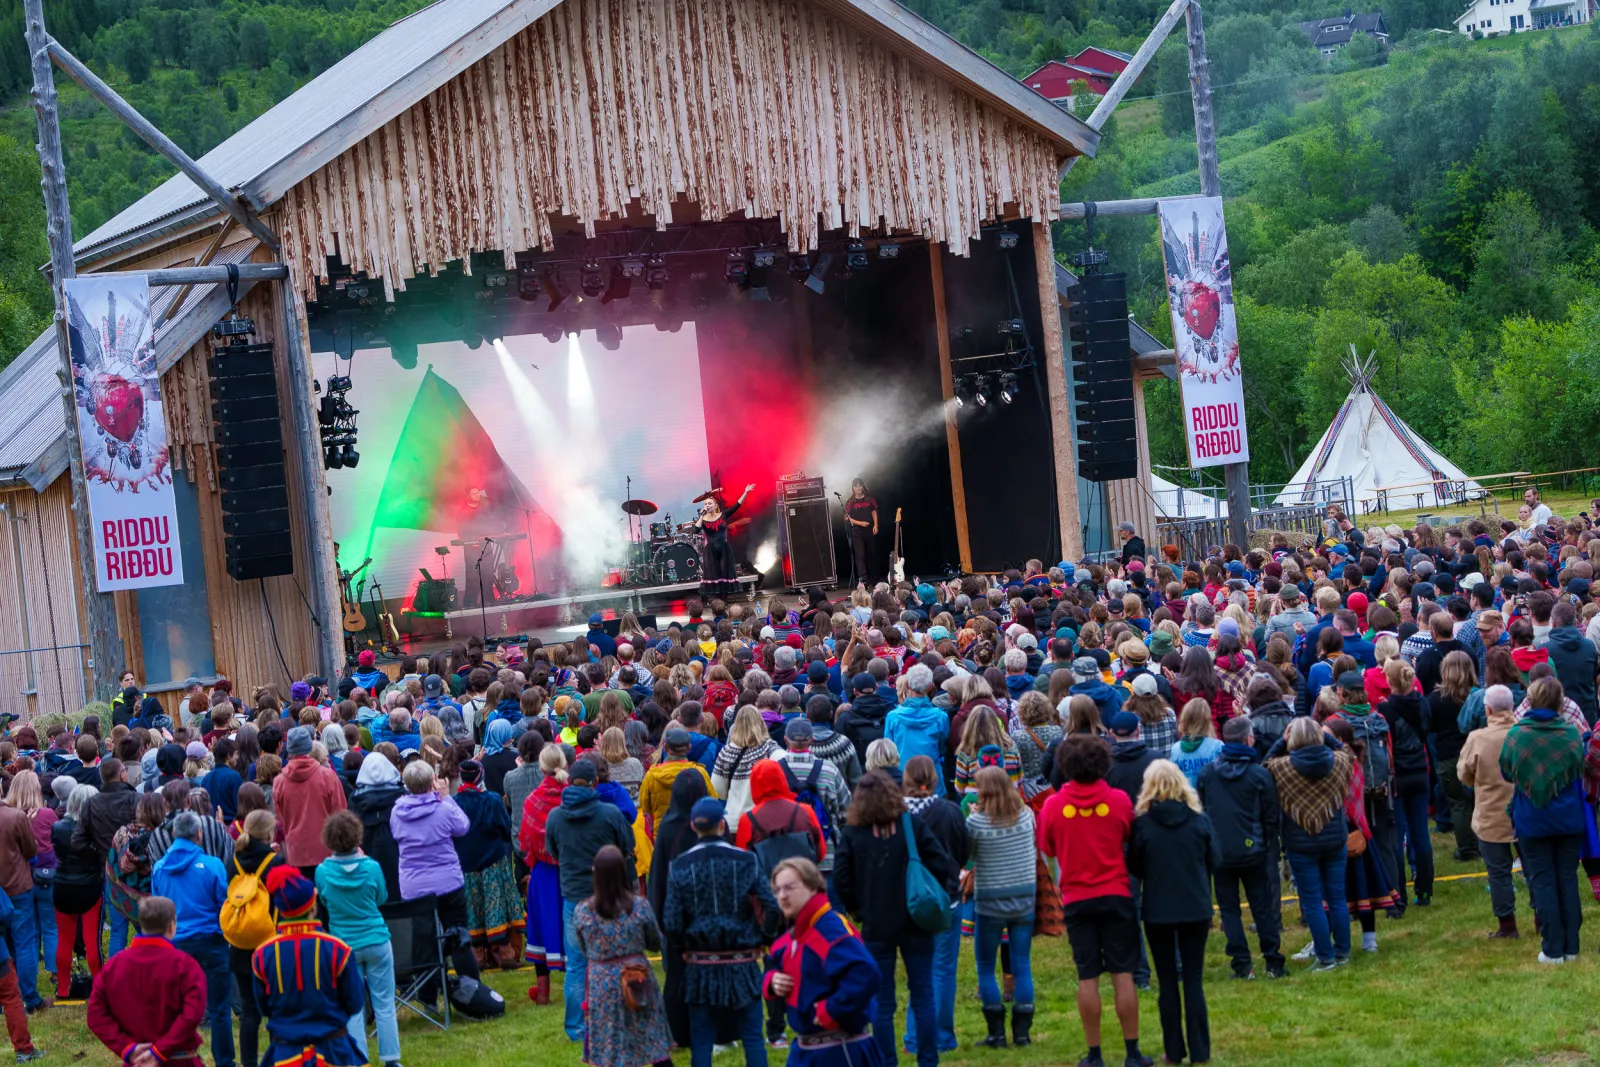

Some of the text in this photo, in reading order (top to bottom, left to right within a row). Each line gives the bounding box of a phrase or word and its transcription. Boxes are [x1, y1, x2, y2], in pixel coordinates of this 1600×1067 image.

[1192, 402, 1239, 431] RIDDU
[1195, 429, 1241, 458] RIĐĐU
[102, 515, 170, 549] RIDDU
[105, 547, 173, 580] RIĐĐU
